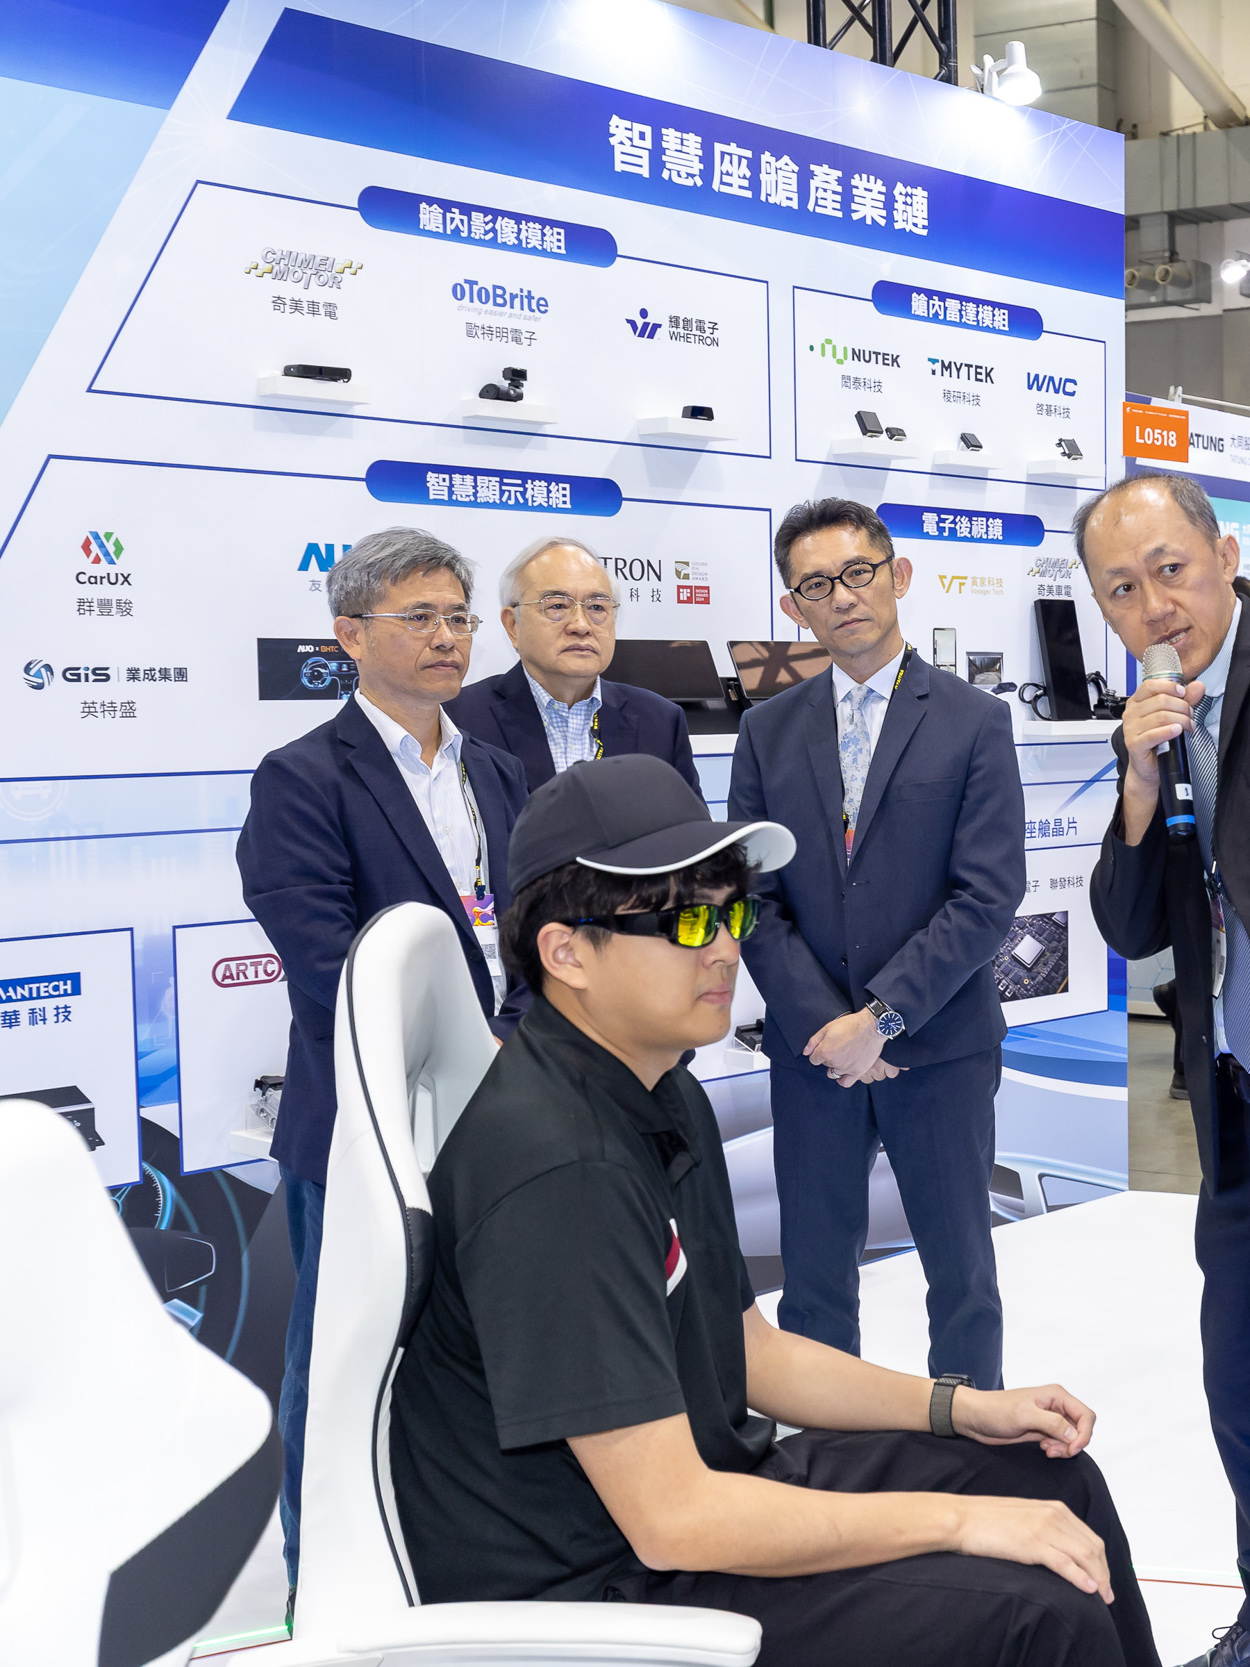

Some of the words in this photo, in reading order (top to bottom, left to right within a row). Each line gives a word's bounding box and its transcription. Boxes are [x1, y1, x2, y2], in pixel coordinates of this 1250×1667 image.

[608, 114, 930, 237] 智慧座艙產業鏈
[418, 201, 567, 256] 艙內影像模組
[261, 247, 335, 273] CHIMEI
[271, 265, 343, 290] MOTOR
[271, 294, 339, 320] 奇美車電
[451, 279, 549, 314] oToBrite
[910, 291, 1010, 332] 艙內雷達模組
[465, 322, 538, 347] 歐特明電子
[668, 314, 719, 335] 輝創電子
[668, 330, 720, 348] WHETRON
[851, 347, 901, 369] NUTEK
[1026, 371, 1078, 397] WNC
[1135, 425, 1178, 448] L0518
[426, 470, 573, 510] 智慧顯示模組
[921, 511, 1005, 542] 電子後視鏡
[1034, 556, 1069, 570] CHIMEI
[1038, 568, 1073, 581] MOTOR
[75, 571, 133, 586] CarUX
[970, 575, 1004, 588] 寅家科技
[629, 587, 662, 603] 科技
[1037, 584, 1073, 598] 奇美車電
[76, 597, 134, 617] 群豐駿
[125, 667, 189, 683] 業成集團
[80, 700, 138, 719] 英特盛
[1049, 875, 1084, 891] 聯發科技
[219, 958, 277, 983] ARTC
[0, 1004, 73, 1029] 華科技
